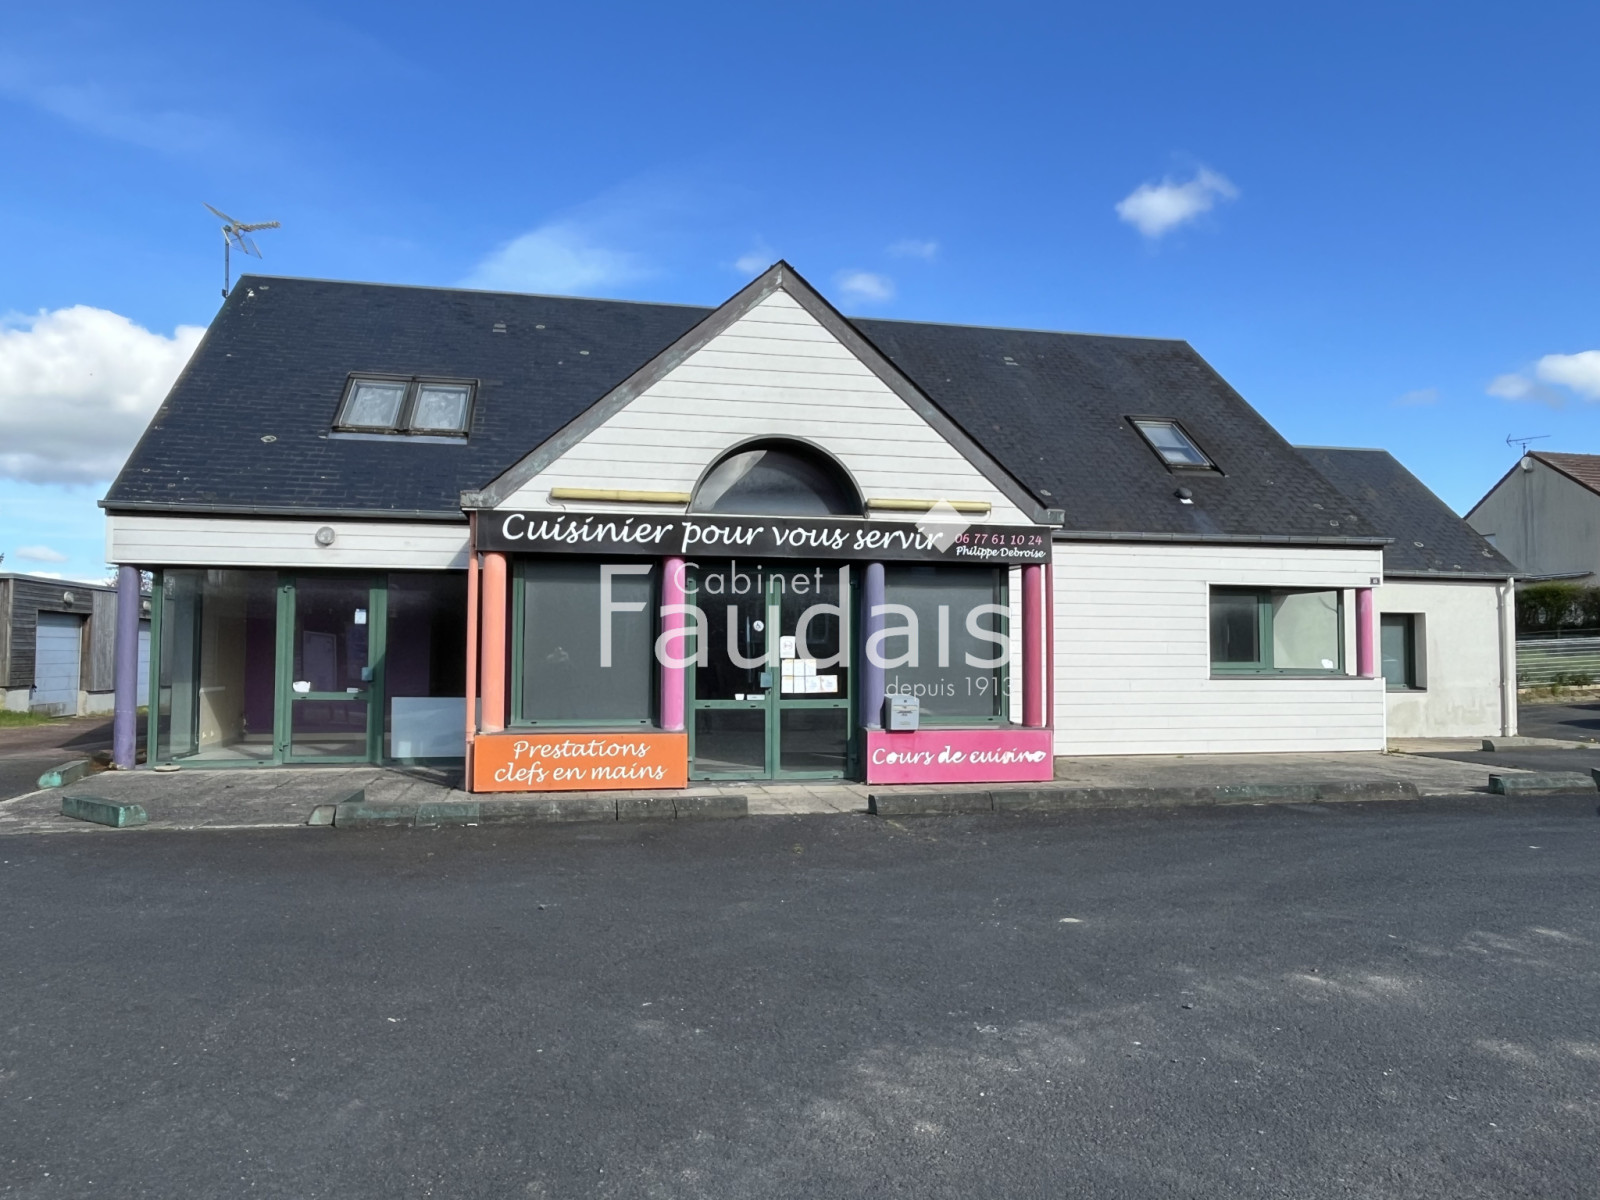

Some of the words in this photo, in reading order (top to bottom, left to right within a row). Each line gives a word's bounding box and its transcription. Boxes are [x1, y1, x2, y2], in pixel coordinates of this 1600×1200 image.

[502, 513, 673, 544] Cuisinier
[681, 521, 763, 553] pour
[771, 526, 850, 549] vous
[853, 526, 943, 550] servir
[955, 533, 970, 544] 06
[974, 533, 988, 544] 77
[991, 534, 1005, 545] 61
[1010, 534, 1025, 545] 10
[1028, 535, 1042, 545] 24
[956, 545, 1000, 559] Philippe
[1000, 547, 1046, 558] Debroise
[513, 739, 650, 759] Prestations
[872, 748, 934, 765] Cours
[937, 745, 967, 763] de
[494, 761, 549, 785] clefs
[553, 769, 586, 780] en
[590, 762, 668, 780] mains
